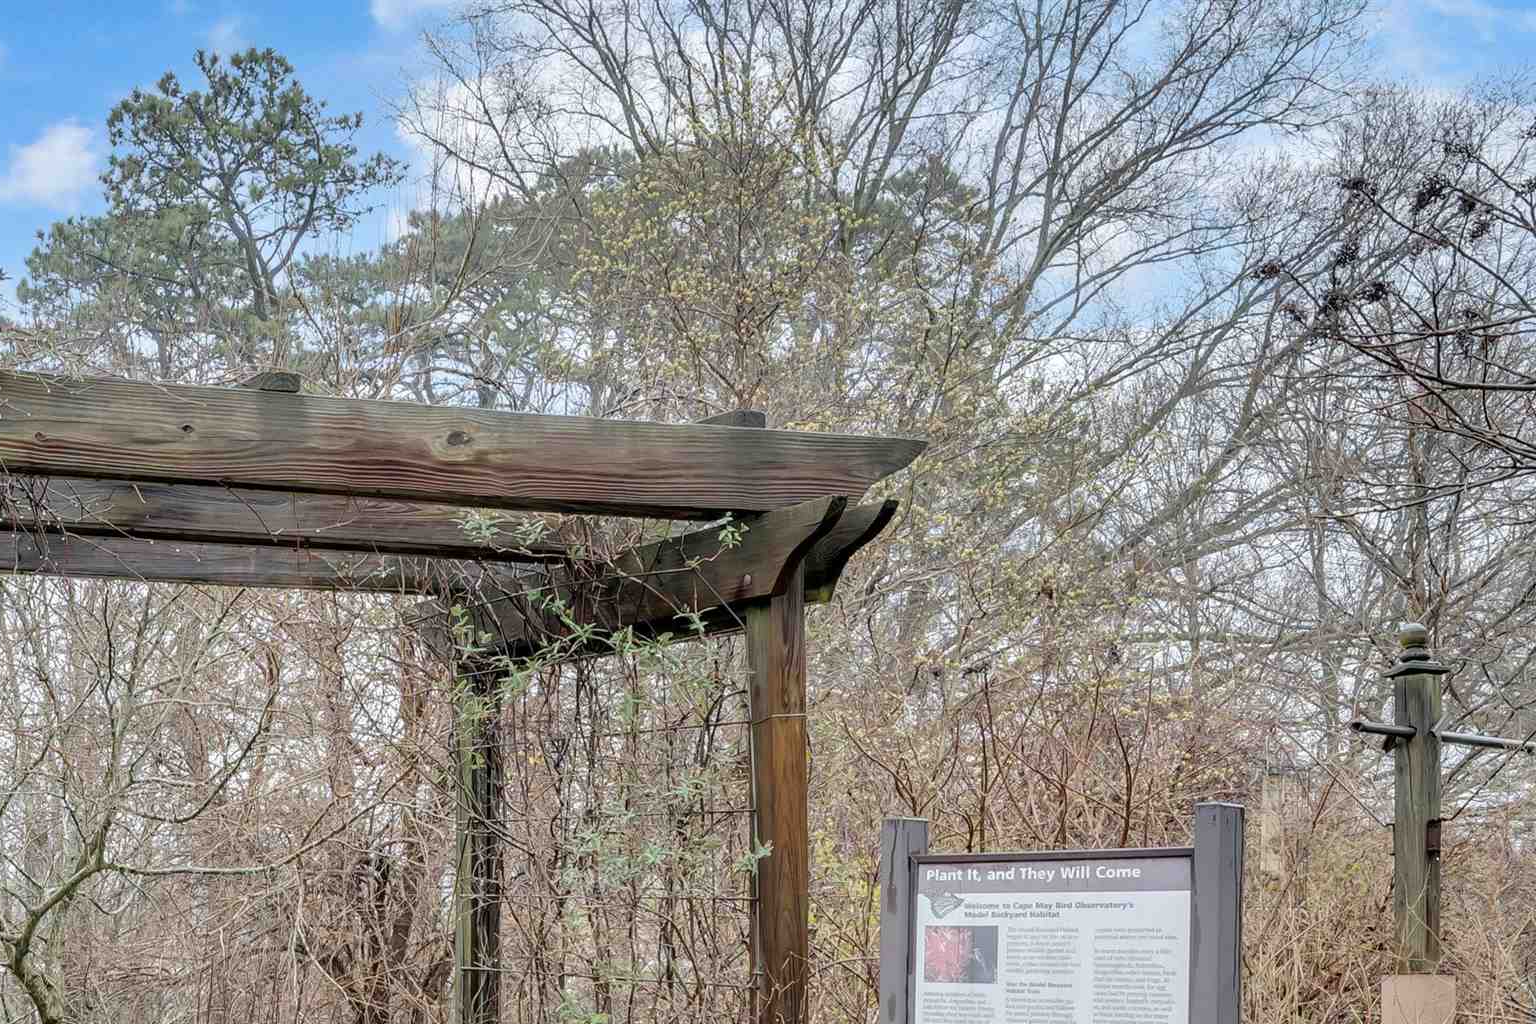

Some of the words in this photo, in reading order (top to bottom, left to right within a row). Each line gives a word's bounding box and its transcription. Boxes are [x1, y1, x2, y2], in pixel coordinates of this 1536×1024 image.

[926, 869, 962, 882] Plant
[967, 868, 982, 883] It,
[987, 867, 1015, 881] and
[1019, 867, 1055, 883] They
[1060, 866, 1090, 880] Will
[1096, 866, 1142, 879] Come
[1013, 902, 1033, 911] Cape
[1035, 902, 1053, 911] May
[1056, 901, 1073, 909] Bird
